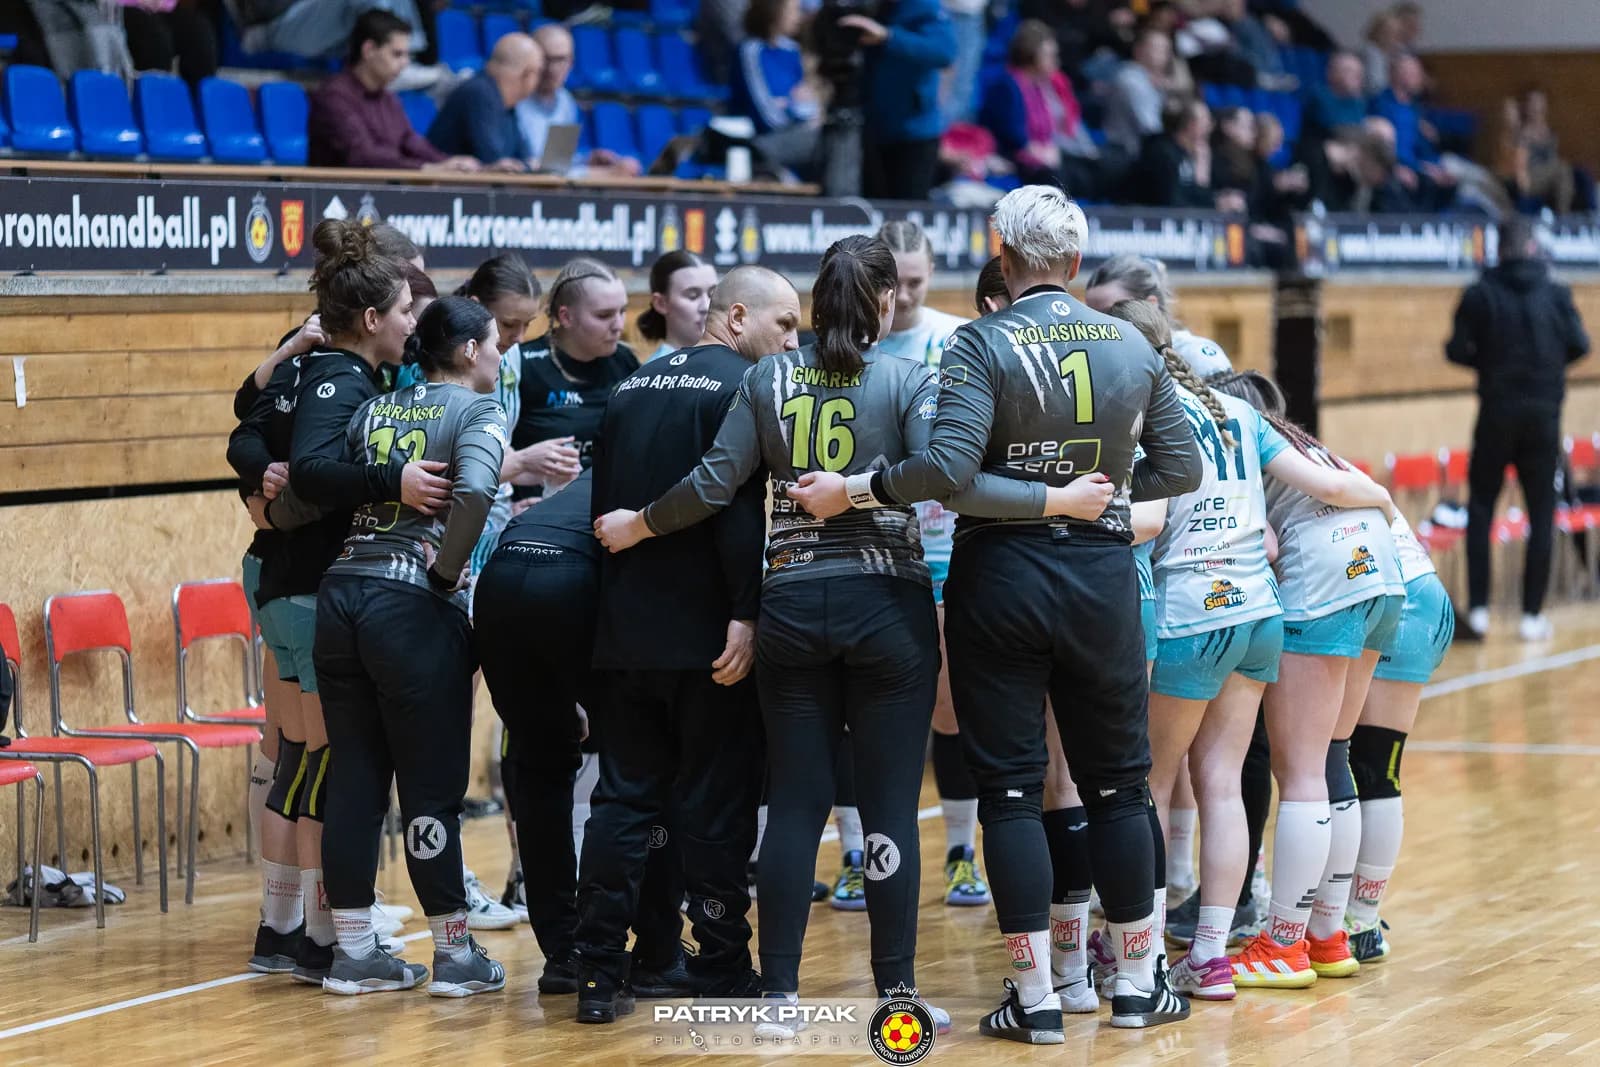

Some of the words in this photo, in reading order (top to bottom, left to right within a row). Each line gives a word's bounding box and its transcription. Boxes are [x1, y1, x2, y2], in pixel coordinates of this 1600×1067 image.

[0, 194, 236, 265] ronahandball.pl
[1014, 320, 1123, 346] KOLASIŃSKA
[649, 374, 679, 390] APR
[677, 374, 722, 392] Radom
[791, 366, 864, 389] GWAREK
[1058, 349, 1096, 425] 1
[372, 404, 445, 422] BARAŃSKA
[780, 394, 857, 473] 16
[1007, 440, 1059, 460] pre
[1187, 516, 1238, 533] zero
